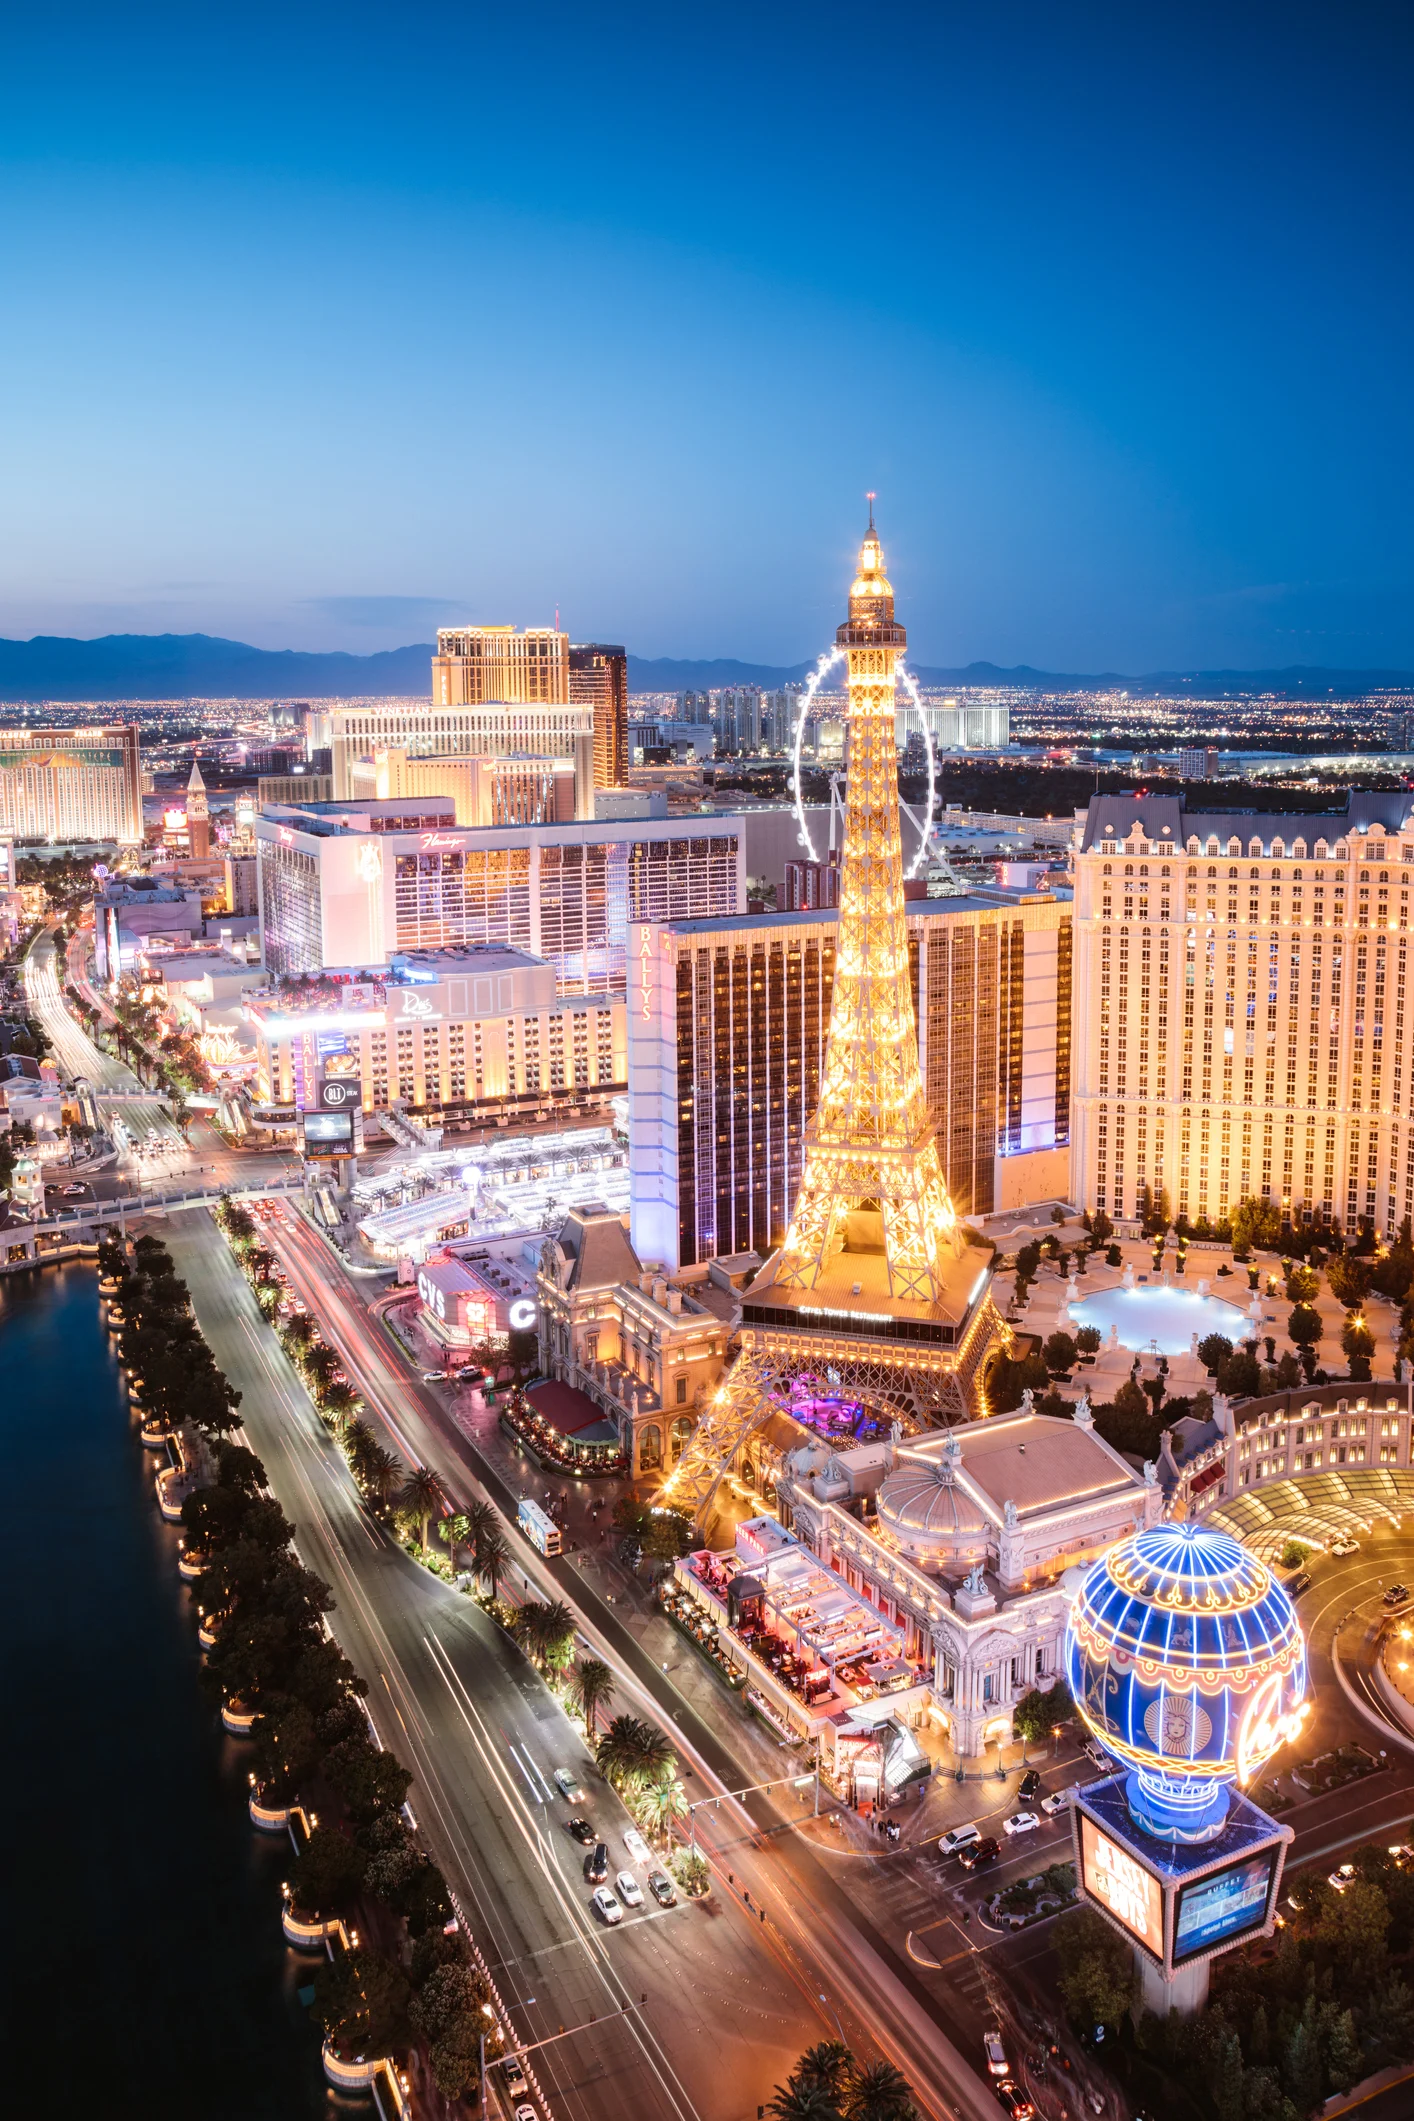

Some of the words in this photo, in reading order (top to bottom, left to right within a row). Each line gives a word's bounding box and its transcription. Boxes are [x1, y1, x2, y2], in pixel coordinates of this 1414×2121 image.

[374, 707, 429, 716] VENETIAN
[0, 731, 32, 739] ASURE
[420, 833, 466, 849] Flamingo
[639, 926, 653, 1021] BALLYS
[303, 1033, 313, 1101] BALLYS
[328, 1087, 341, 1100] BLT
[418, 1271, 446, 1320] CVS
[509, 1299, 537, 1329] C
[799, 1305, 823, 1315] EIFFEL
[823, 1307, 848, 1317] TOWER
[850, 1311, 893, 1323] RESTAURANT
[735, 1522, 749, 1541] BEER
[750, 1535, 765, 1556] PARK
[1095, 1834, 1150, 1905] JERSEY
[1207, 1876, 1241, 1895] BUFFET
